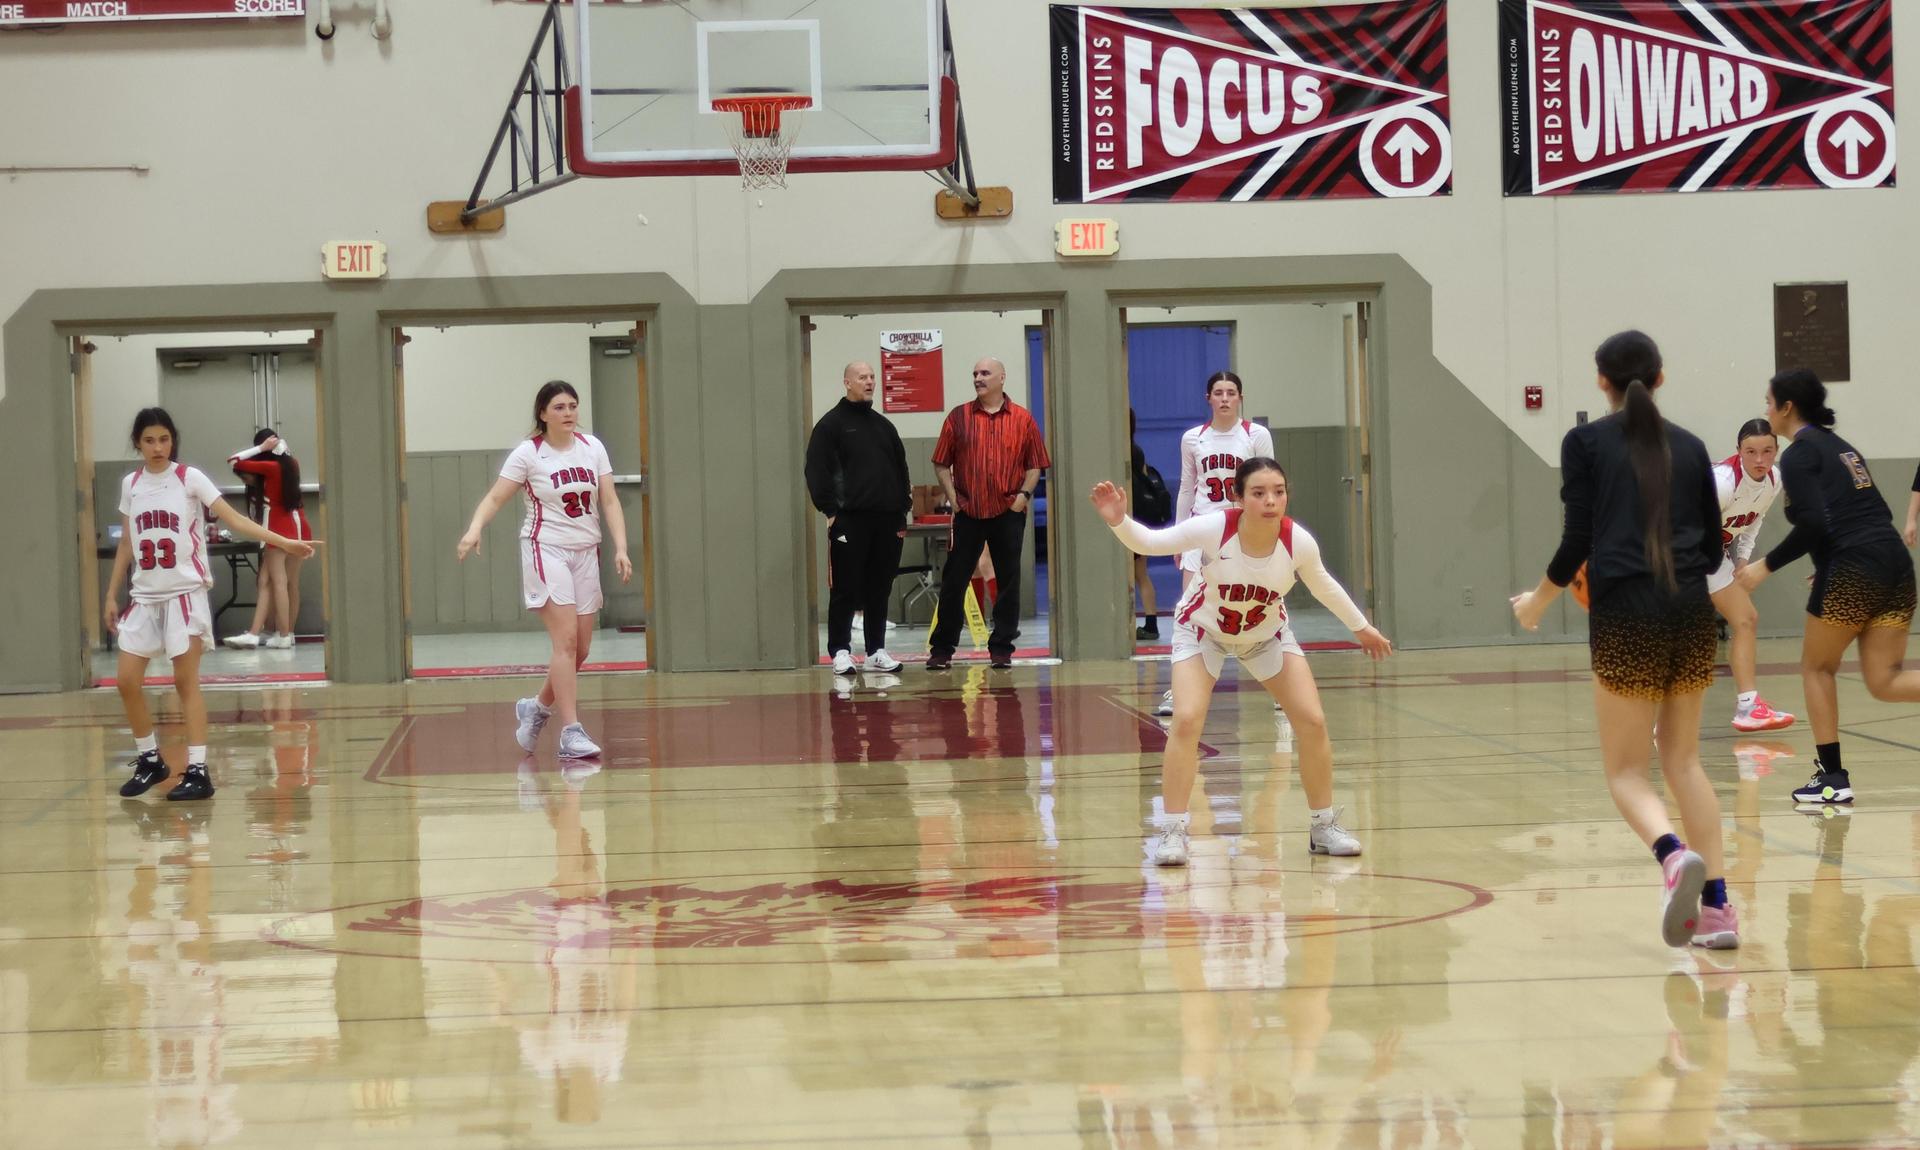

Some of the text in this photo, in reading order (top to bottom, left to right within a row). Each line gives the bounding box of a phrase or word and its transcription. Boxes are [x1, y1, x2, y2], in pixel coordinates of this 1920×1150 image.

[0, 4, 24, 18] RE
[67, 2, 127, 17] MATCH
[1061, 46, 1071, 162] ABOVETHEINFLUENCE.COM
[1093, 36, 1115, 170] REDSKINS
[1124, 35, 1323, 169] FOCUS
[1510, 38, 1520, 155] ABOVETHEINFLUENCE.COM
[1541, 28, 1564, 162] REDSKINS
[1569, 27, 1769, 163] ONWARD
[1071, 223, 1106, 250] EXIT
[337, 245, 373, 272] EXIT
[550, 467, 596, 489] TRIBE
[561, 491, 592, 518] 21
[135, 510, 180, 535] TRIBE
[139, 538, 176, 570] 33
[1216, 605, 1267, 635] 35
